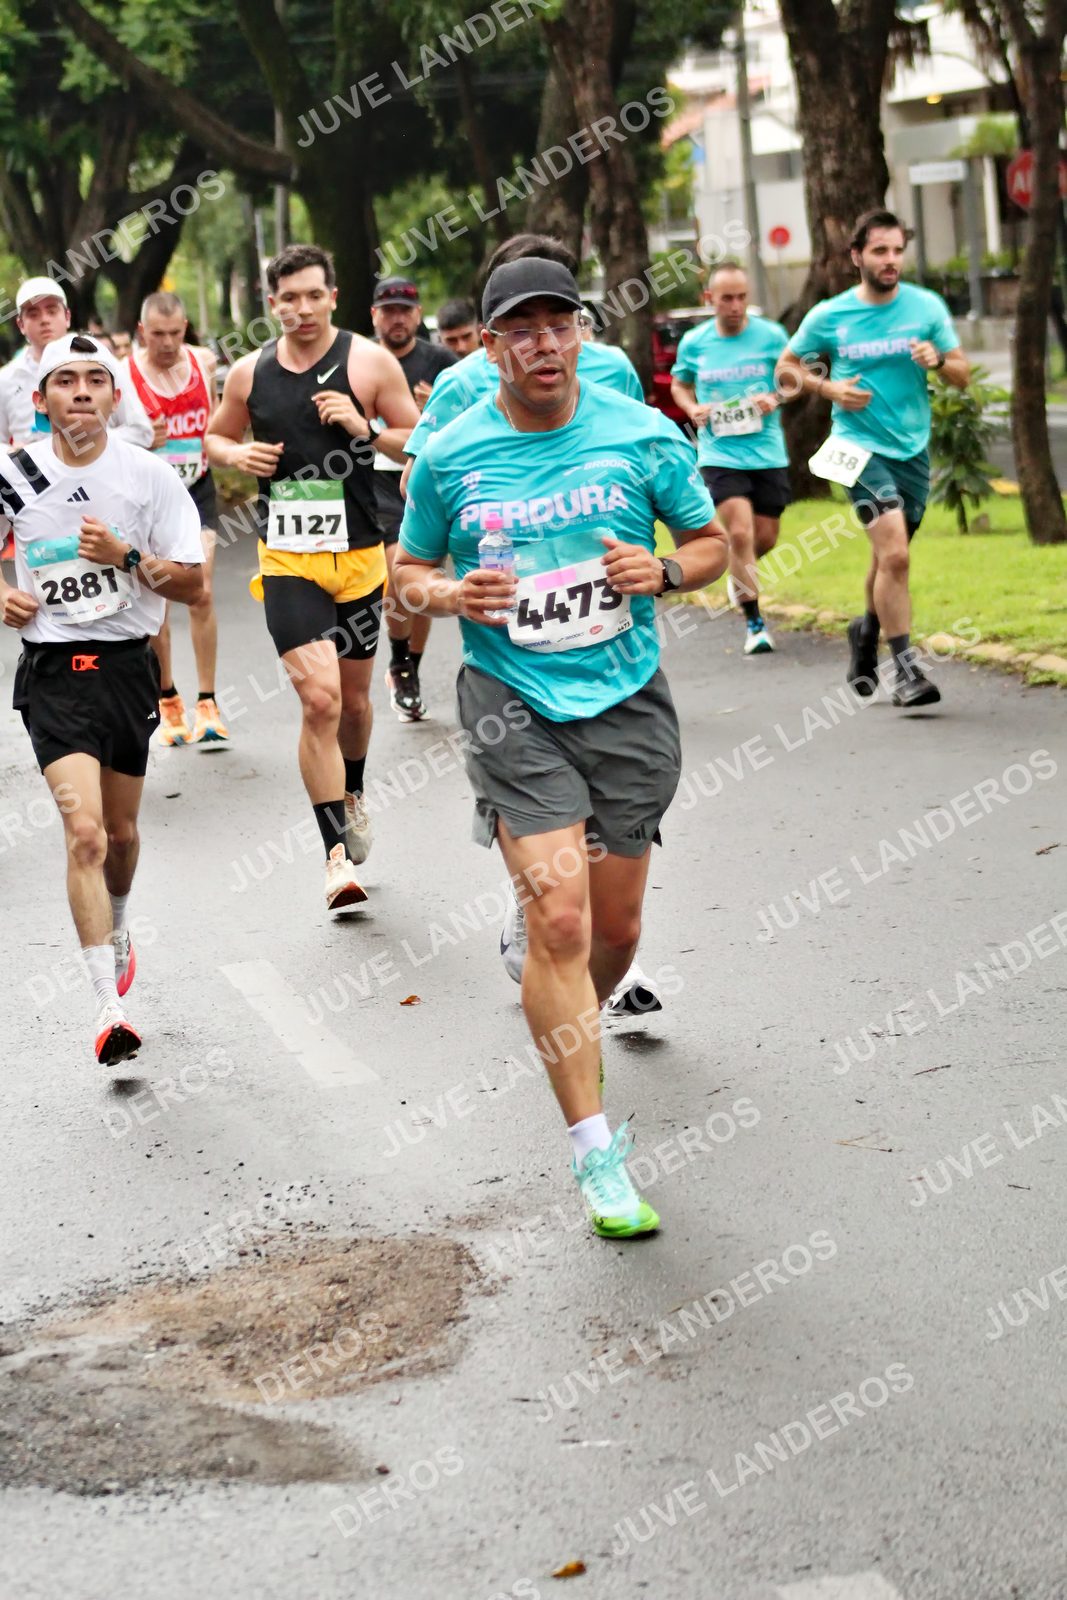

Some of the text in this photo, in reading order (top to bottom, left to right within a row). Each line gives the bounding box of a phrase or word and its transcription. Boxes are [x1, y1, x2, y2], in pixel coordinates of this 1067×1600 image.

[277, 514, 341, 535] 1127
[459, 483, 629, 530] PERDURA
[41, 567, 118, 605] 2881
[516, 578, 623, 630] 4473
